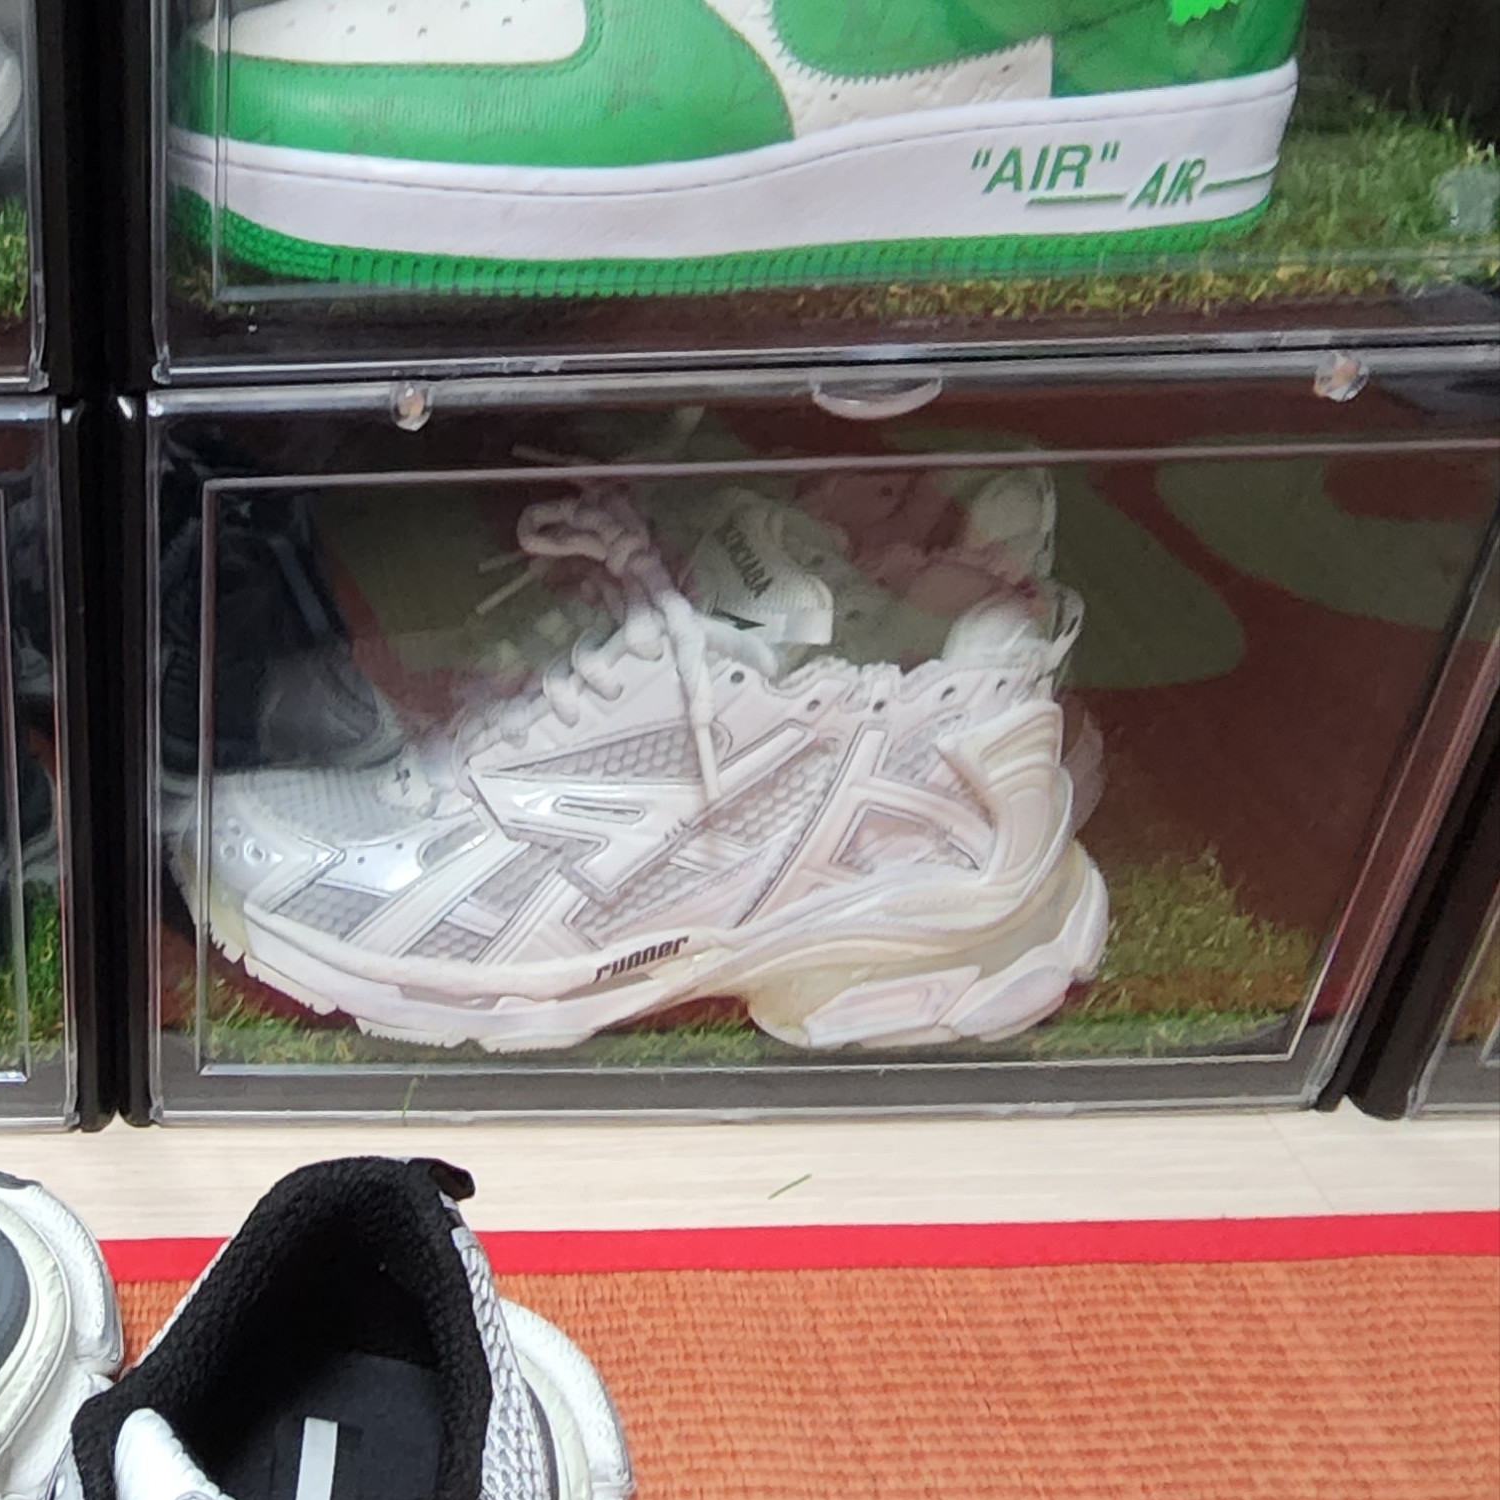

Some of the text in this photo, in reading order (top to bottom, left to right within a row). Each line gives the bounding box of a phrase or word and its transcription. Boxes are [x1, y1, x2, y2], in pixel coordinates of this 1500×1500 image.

[971, 141, 1206, 210] "AIR" AIR
[593, 935, 690, 984] runner
